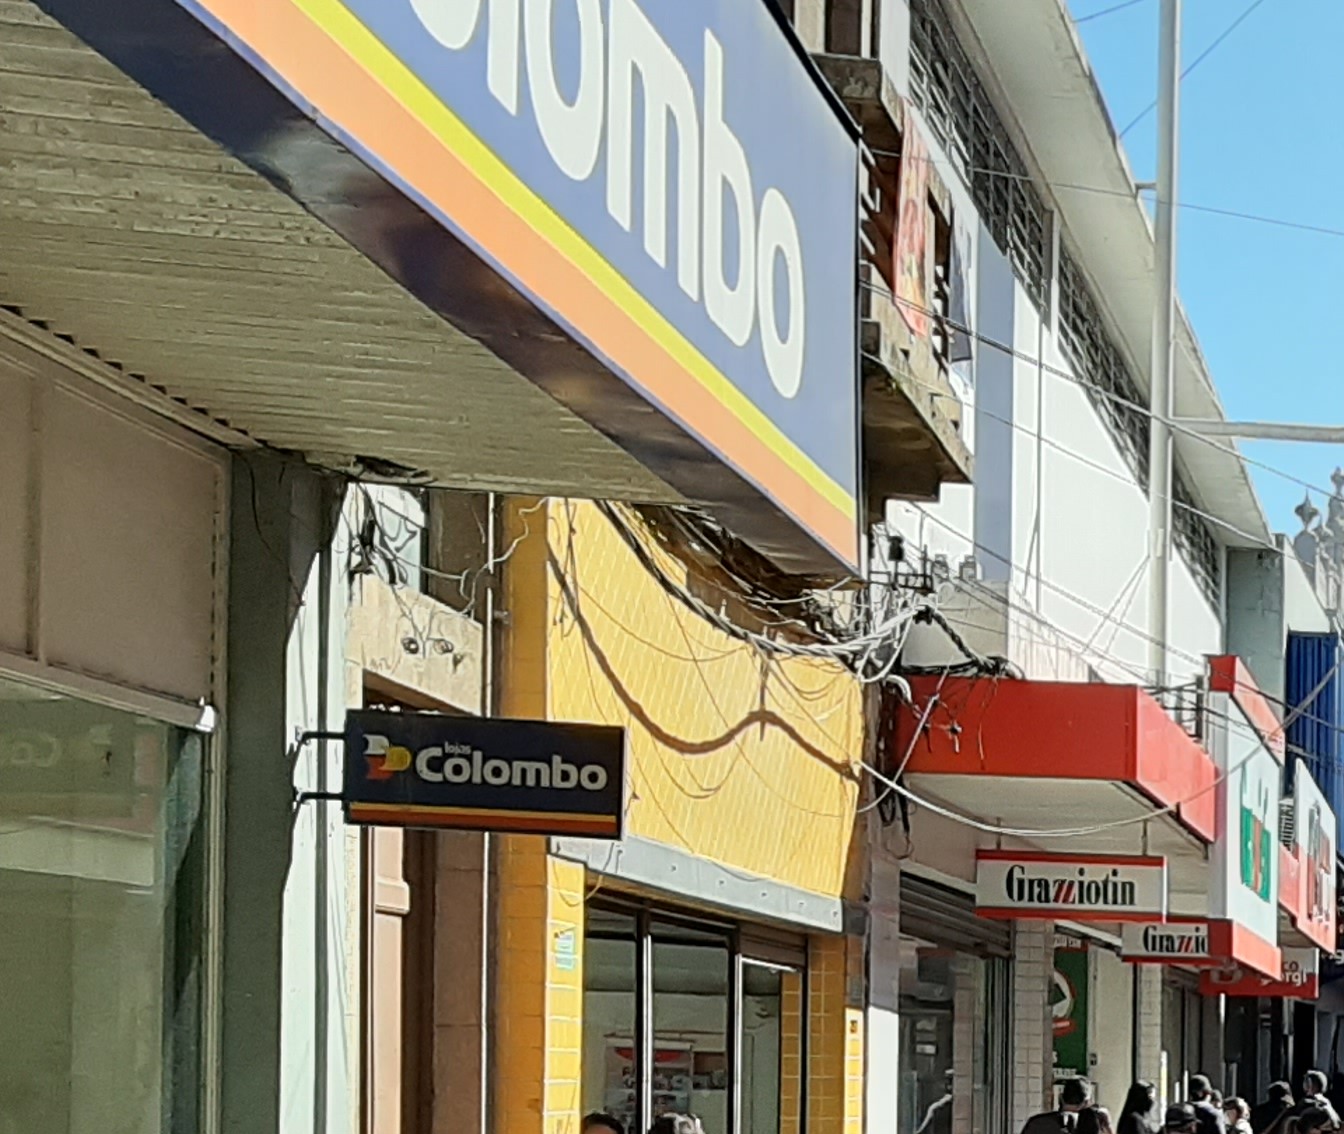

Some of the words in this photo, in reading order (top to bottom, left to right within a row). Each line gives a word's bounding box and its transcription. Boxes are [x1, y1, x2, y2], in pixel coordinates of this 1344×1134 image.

[410, 0, 805, 399] ombo
[415, 746, 608, 791] Colombo
[1005, 864, 1136, 906] Grazziotin
